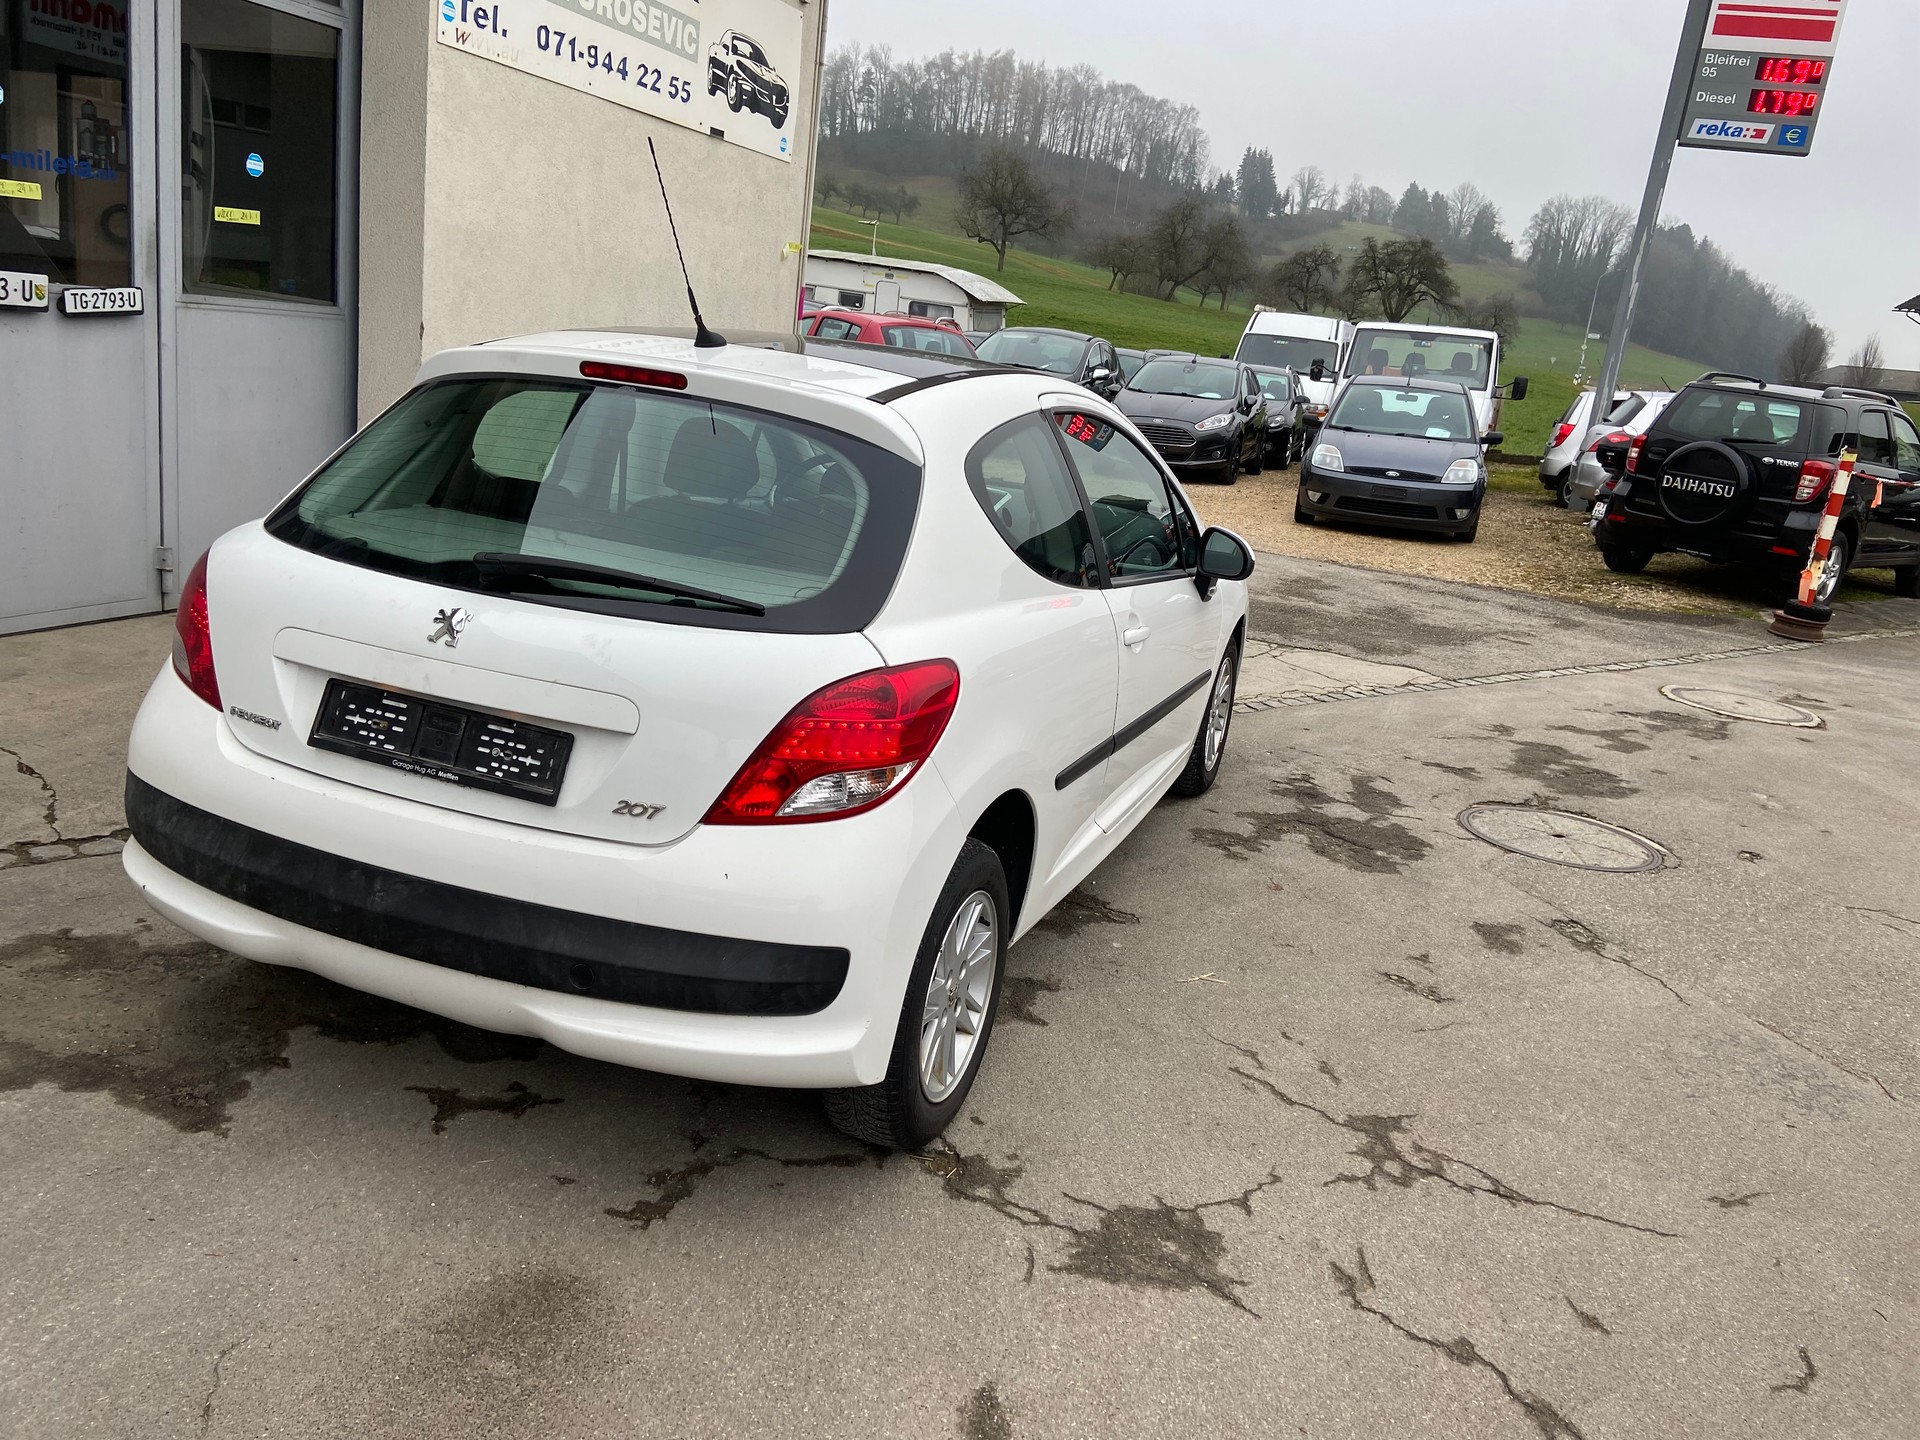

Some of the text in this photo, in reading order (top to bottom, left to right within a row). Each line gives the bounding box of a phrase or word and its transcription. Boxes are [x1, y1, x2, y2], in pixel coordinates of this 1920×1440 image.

[461, 0, 692, 103] Tel. 071-944 22 55
[1705, 53, 1751, 66] Bleifrei
[1702, 66, 1717, 77] 95
[1696, 91, 1736, 104] Diesel
[1662, 475, 1735, 498] DAIHATSU
[230, 706, 282, 731] PEUGEOT
[392, 759, 414, 770] Garage
[611, 799, 667, 820] 207
